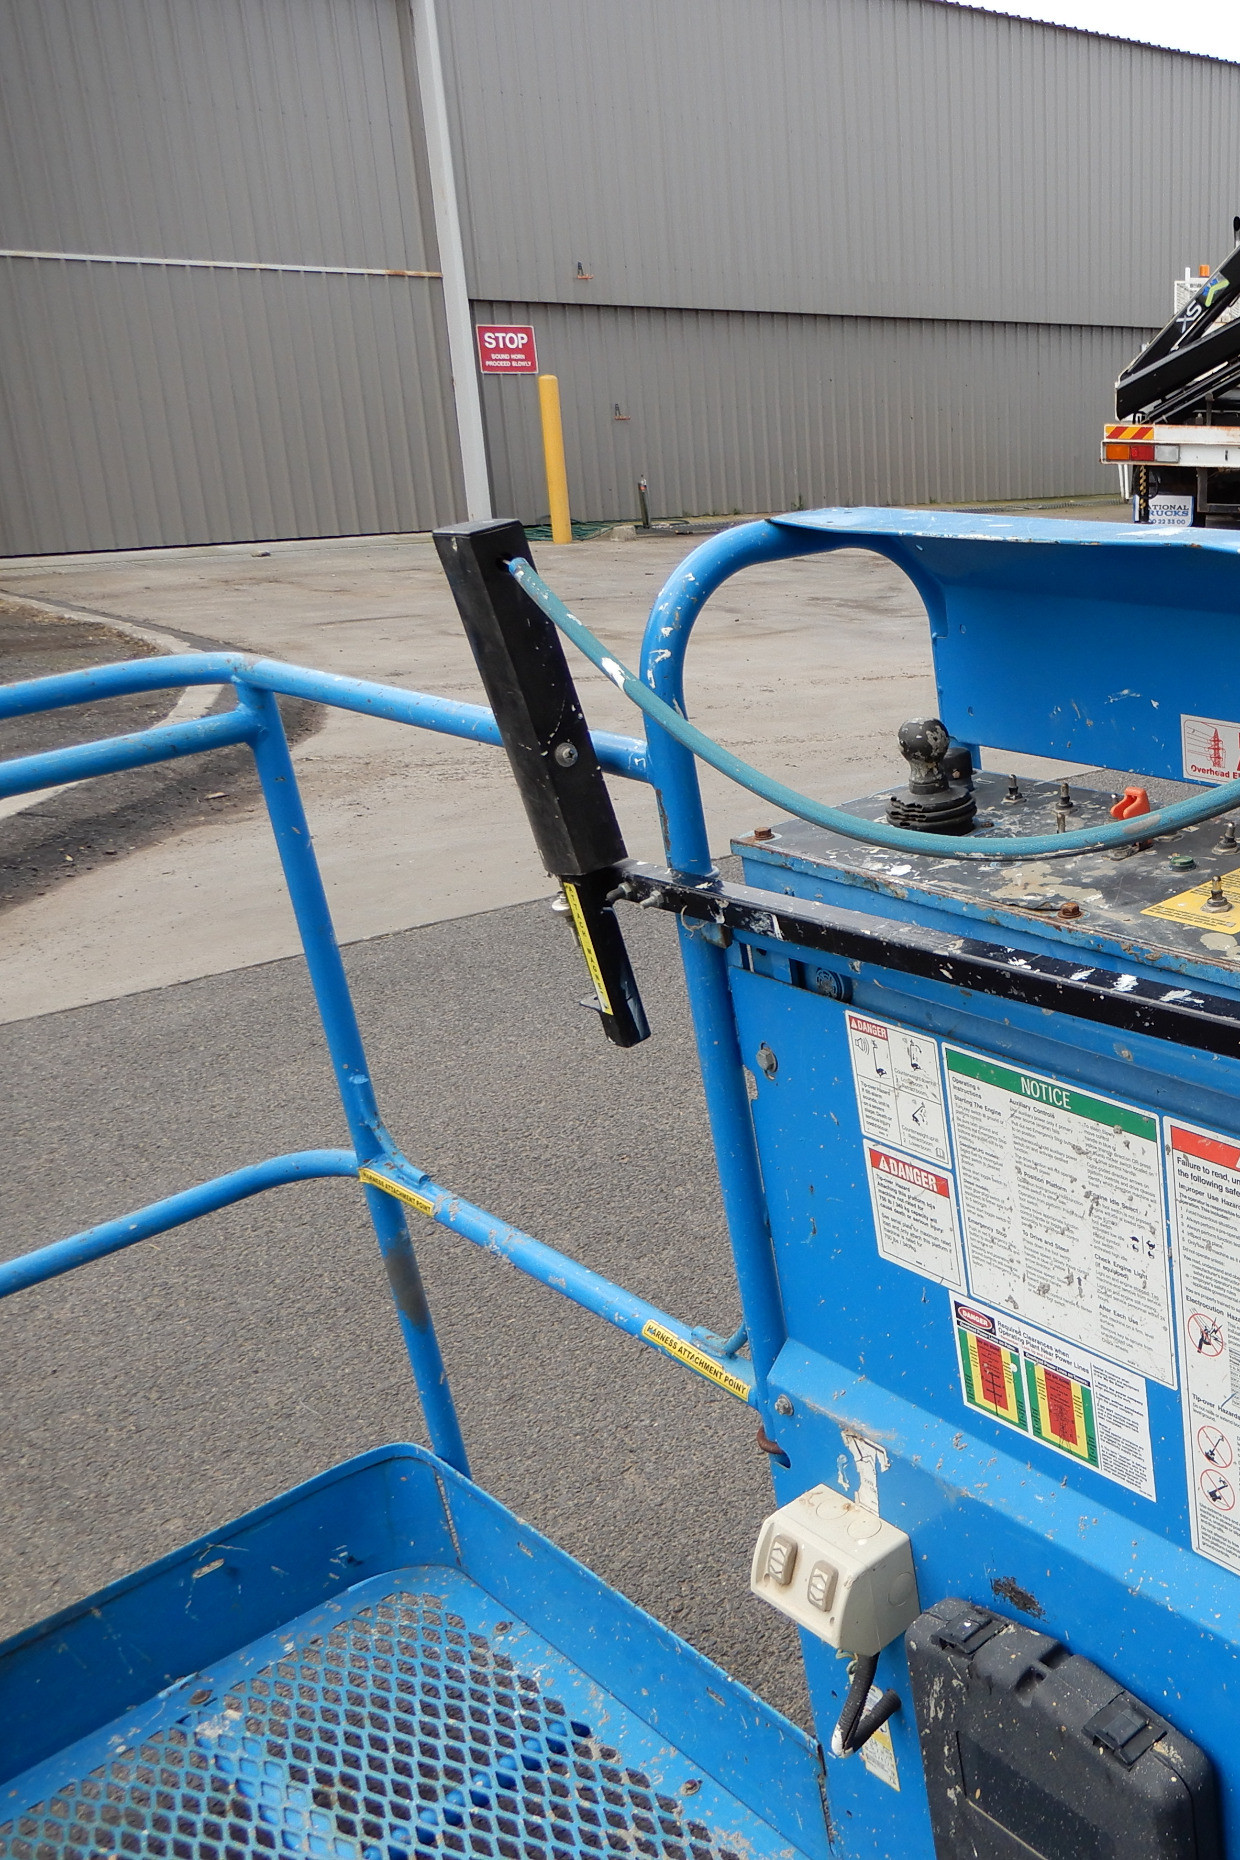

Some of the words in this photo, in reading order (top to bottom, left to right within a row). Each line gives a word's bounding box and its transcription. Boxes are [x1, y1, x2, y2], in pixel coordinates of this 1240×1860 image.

[484, 332, 528, 348] STOP
[1190, 764, 1230, 778] Overhead
[857, 1019, 886, 1038] DANGER
[1020, 1075, 1071, 1110] NOTICE
[954, 1094, 972, 1107] Starting
[984, 1105, 1001, 1117] Engine
[1008, 1098, 1030, 1111] Auxiliary
[888, 1158, 937, 1192] DANGER
[1023, 1170, 1044, 1183] Position
[1045, 1179, 1067, 1192] Platform
[1176, 1156, 1200, 1172] Failure
[1202, 1165, 1209, 1175] to
[1211, 1168, 1229, 1183] read,
[1177, 1168, 1188, 1179] the
[1190, 1172, 1223, 1193] following
[1178, 1182, 1204, 1198] Improper
[1206, 1192, 1218, 1202] Use
[1094, 1253, 1110, 1265] Check
[1113, 1261, 1131, 1274] Engine
[1133, 1269, 1148, 1281] Light
[1185, 1294, 1224, 1316] Electrocution
[962, 1309, 988, 1327] DANGER
[1113, 1310, 1126, 1320] Each
[1128, 1316, 1138, 1325] Use
[998, 1320, 1021, 1336] Required
[1023, 1332, 1053, 1351] Clearances
[1054, 1346, 1069, 1358] when
[998, 1327, 1024, 1344] Operating
[1025, 1339, 1039, 1350] Plant
[1040, 1346, 1053, 1357] Near
[1055, 1353, 1072, 1366] Power
[1073, 1361, 1089, 1374] Lines
[646, 1325, 678, 1350] HARNESS
[678, 1346, 724, 1380] ATTACHMENT
[724, 1376, 746, 1394] POINT
[1192, 1393, 1214, 1409] Tip-over
[1217, 1404, 1240, 1421] Hazards
